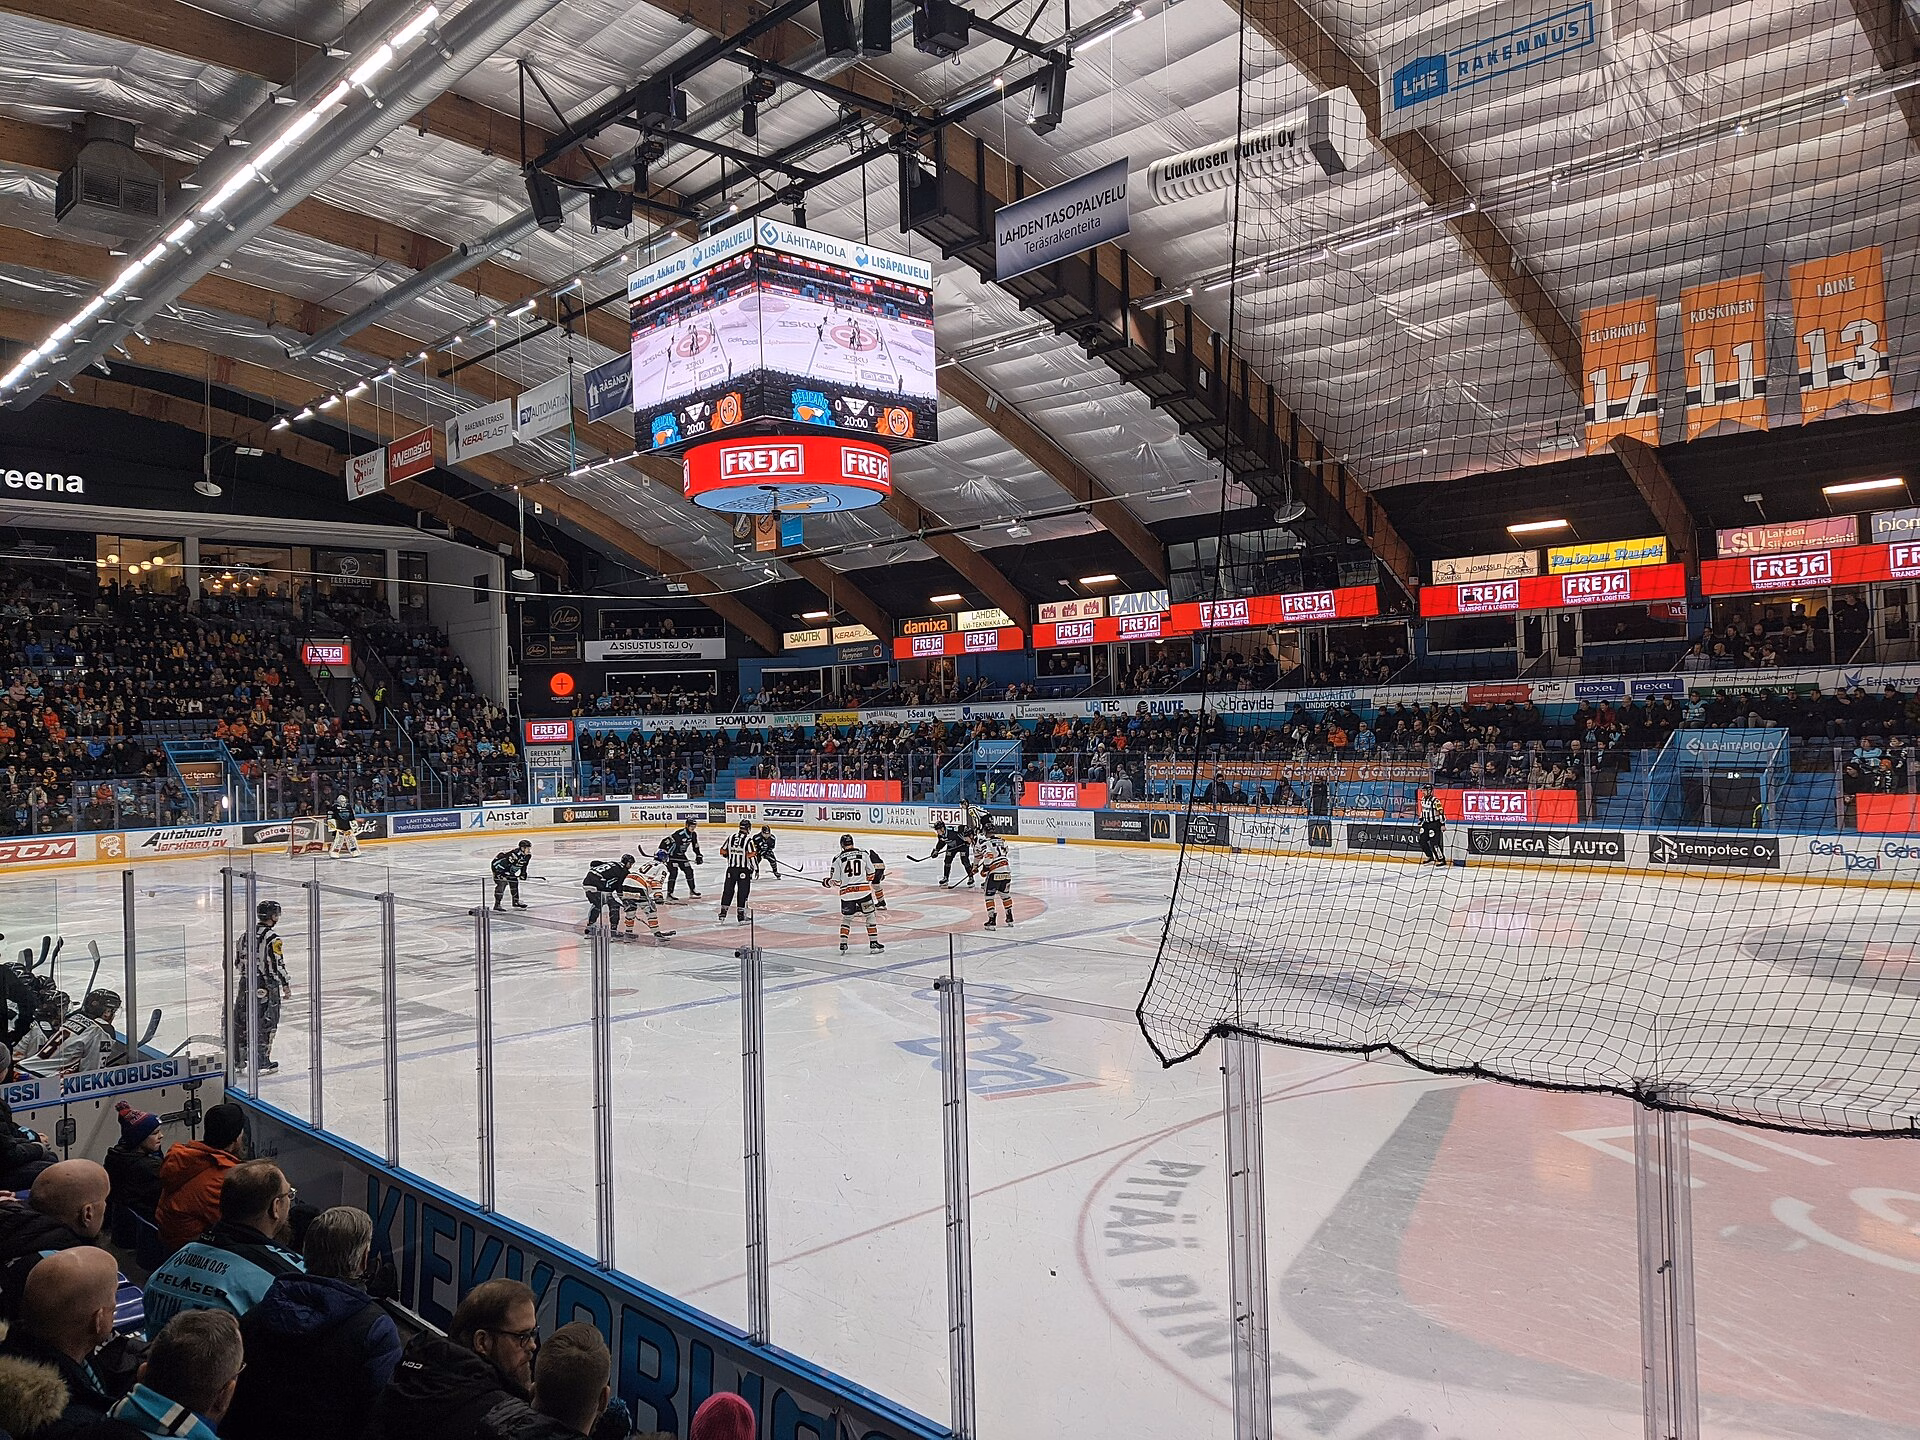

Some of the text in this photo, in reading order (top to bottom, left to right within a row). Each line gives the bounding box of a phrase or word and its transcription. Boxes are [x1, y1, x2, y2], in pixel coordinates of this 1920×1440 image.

[1457, 21, 1579, 76] RAKENNUS
[1402, 70, 1439, 97] LHE
[1164, 128, 1296, 182] Liukkosen Pultti Oy
[999, 184, 1127, 247] LAHDEN TASOPALVELU
[704, 227, 753, 259] LISÄPALVELU
[1024, 215, 1102, 255] Teräsrakenteita
[781, 231, 847, 259] LÄHITAPIOLA
[871, 255, 929, 281] LISÄPALVELU
[1816, 276, 1856, 298] LAINE
[1689, 298, 1756, 325] KOSKINEN
[1589, 320, 1648, 344] ELORANTA
[1802, 318, 1882, 390] 13
[599, 371, 631, 392] RÄSÄNEN
[1694, 342, 1755, 408] 11
[1588, 360, 1650, 425] 17
[704, 404, 710, 416] 0
[834, 400, 842, 411] 0
[868, 405, 875, 417] 0
[680, 412, 686, 424] 0
[843, 415, 869, 429] 20:00
[462, 424, 509, 447] KERAPLAST
[686, 420, 705, 436] 20:00
[725, 449, 798, 474] FREJA
[847, 453, 887, 480] FREJA
[0, 469, 84, 493] eena
[1767, 527, 1805, 539] Lahden
[1718, 531, 1766, 555] LSU
[1756, 555, 1825, 579] FREJA
[1566, 574, 1626, 594] FREJA
[1461, 583, 1515, 602] FREJA
[1284, 593, 1331, 612] FREJA
[971, 609, 1001, 620] LAHDEN
[1203, 602, 1245, 620] FREJA
[903, 619, 949, 635] damixa
[1058, 622, 1092, 638] FREJA
[1122, 616, 1158, 632] FREJA
[789, 629, 821, 644] SAKUTEK
[913, 637, 943, 652] FREJA
[966, 632, 996, 647] FREJA
[309, 648, 340, 658] FREJA
[663, 641, 694, 650] T&J Oy
[1538, 684, 1560, 692] QMG
[1150, 700, 1184, 713] RAUTE
[1228, 696, 1274, 710] bravida
[715, 715, 766, 725] EKOMUOVI
[907, 709, 927, 718] T-Seal
[534, 725, 565, 736] FREJA
[530, 750, 561, 758] GREENSTAR
[1705, 741, 1775, 752] LÄHITAPIOLA
[530, 757, 562, 767] HOTEL
[1041, 785, 1075, 799] FREJA
[887, 808, 915, 816] LAHDEN
[1468, 795, 1523, 813] FREJA
[486, 810, 530, 822] Anstar
[575, 809, 598, 818] KARJALA
[640, 810, 673, 821] Rauta
[763, 808, 804, 818] SPEED
[831, 809, 861, 821] LEPISTÖ
[887, 815, 921, 825] JÄÄHALLI
[930, 810, 961, 822] FREJA
[141, 827, 223, 847] Autohuolto
[1188, 824, 1216, 835] TRIPLA
[1242, 822, 1275, 836] Layher
[1369, 834, 1420, 843] LAHTI AQU
[1498, 837, 1619, 856] MEGA AUTO
[1679, 842, 1775, 860] Tempotec Oy
[843, 859, 861, 877] 40
[64, 1060, 179, 1094] KIEKKOBUSSI
[1103, 1159, 1206, 1258] PITÄÄ
